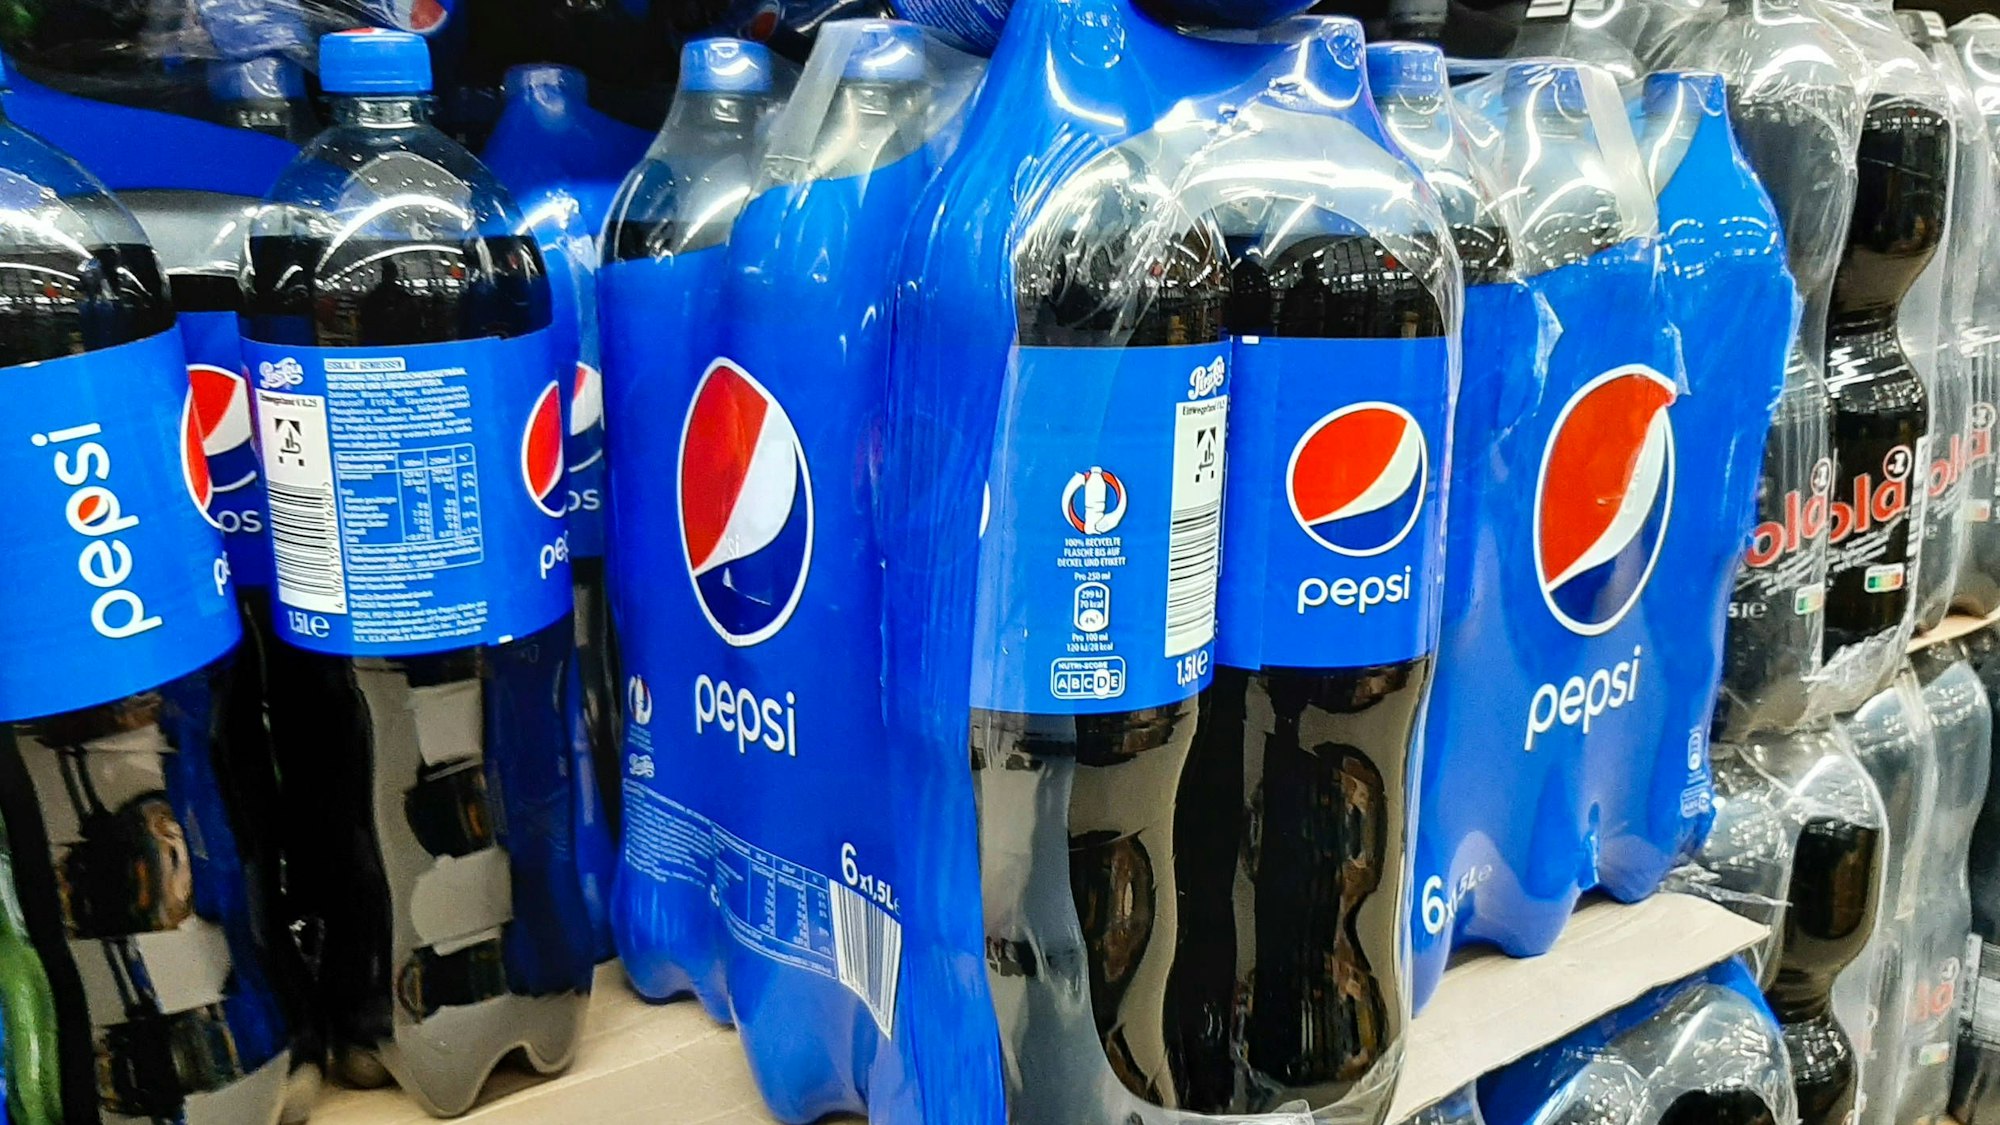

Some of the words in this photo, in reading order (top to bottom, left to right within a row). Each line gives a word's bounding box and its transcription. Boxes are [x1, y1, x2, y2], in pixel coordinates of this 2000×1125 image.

[31, 423, 163, 639] pepsi
[1297, 565, 1411, 614] pepsi
[695, 674, 797, 756] pepsi
[1524, 644, 1641, 751] pepsi
